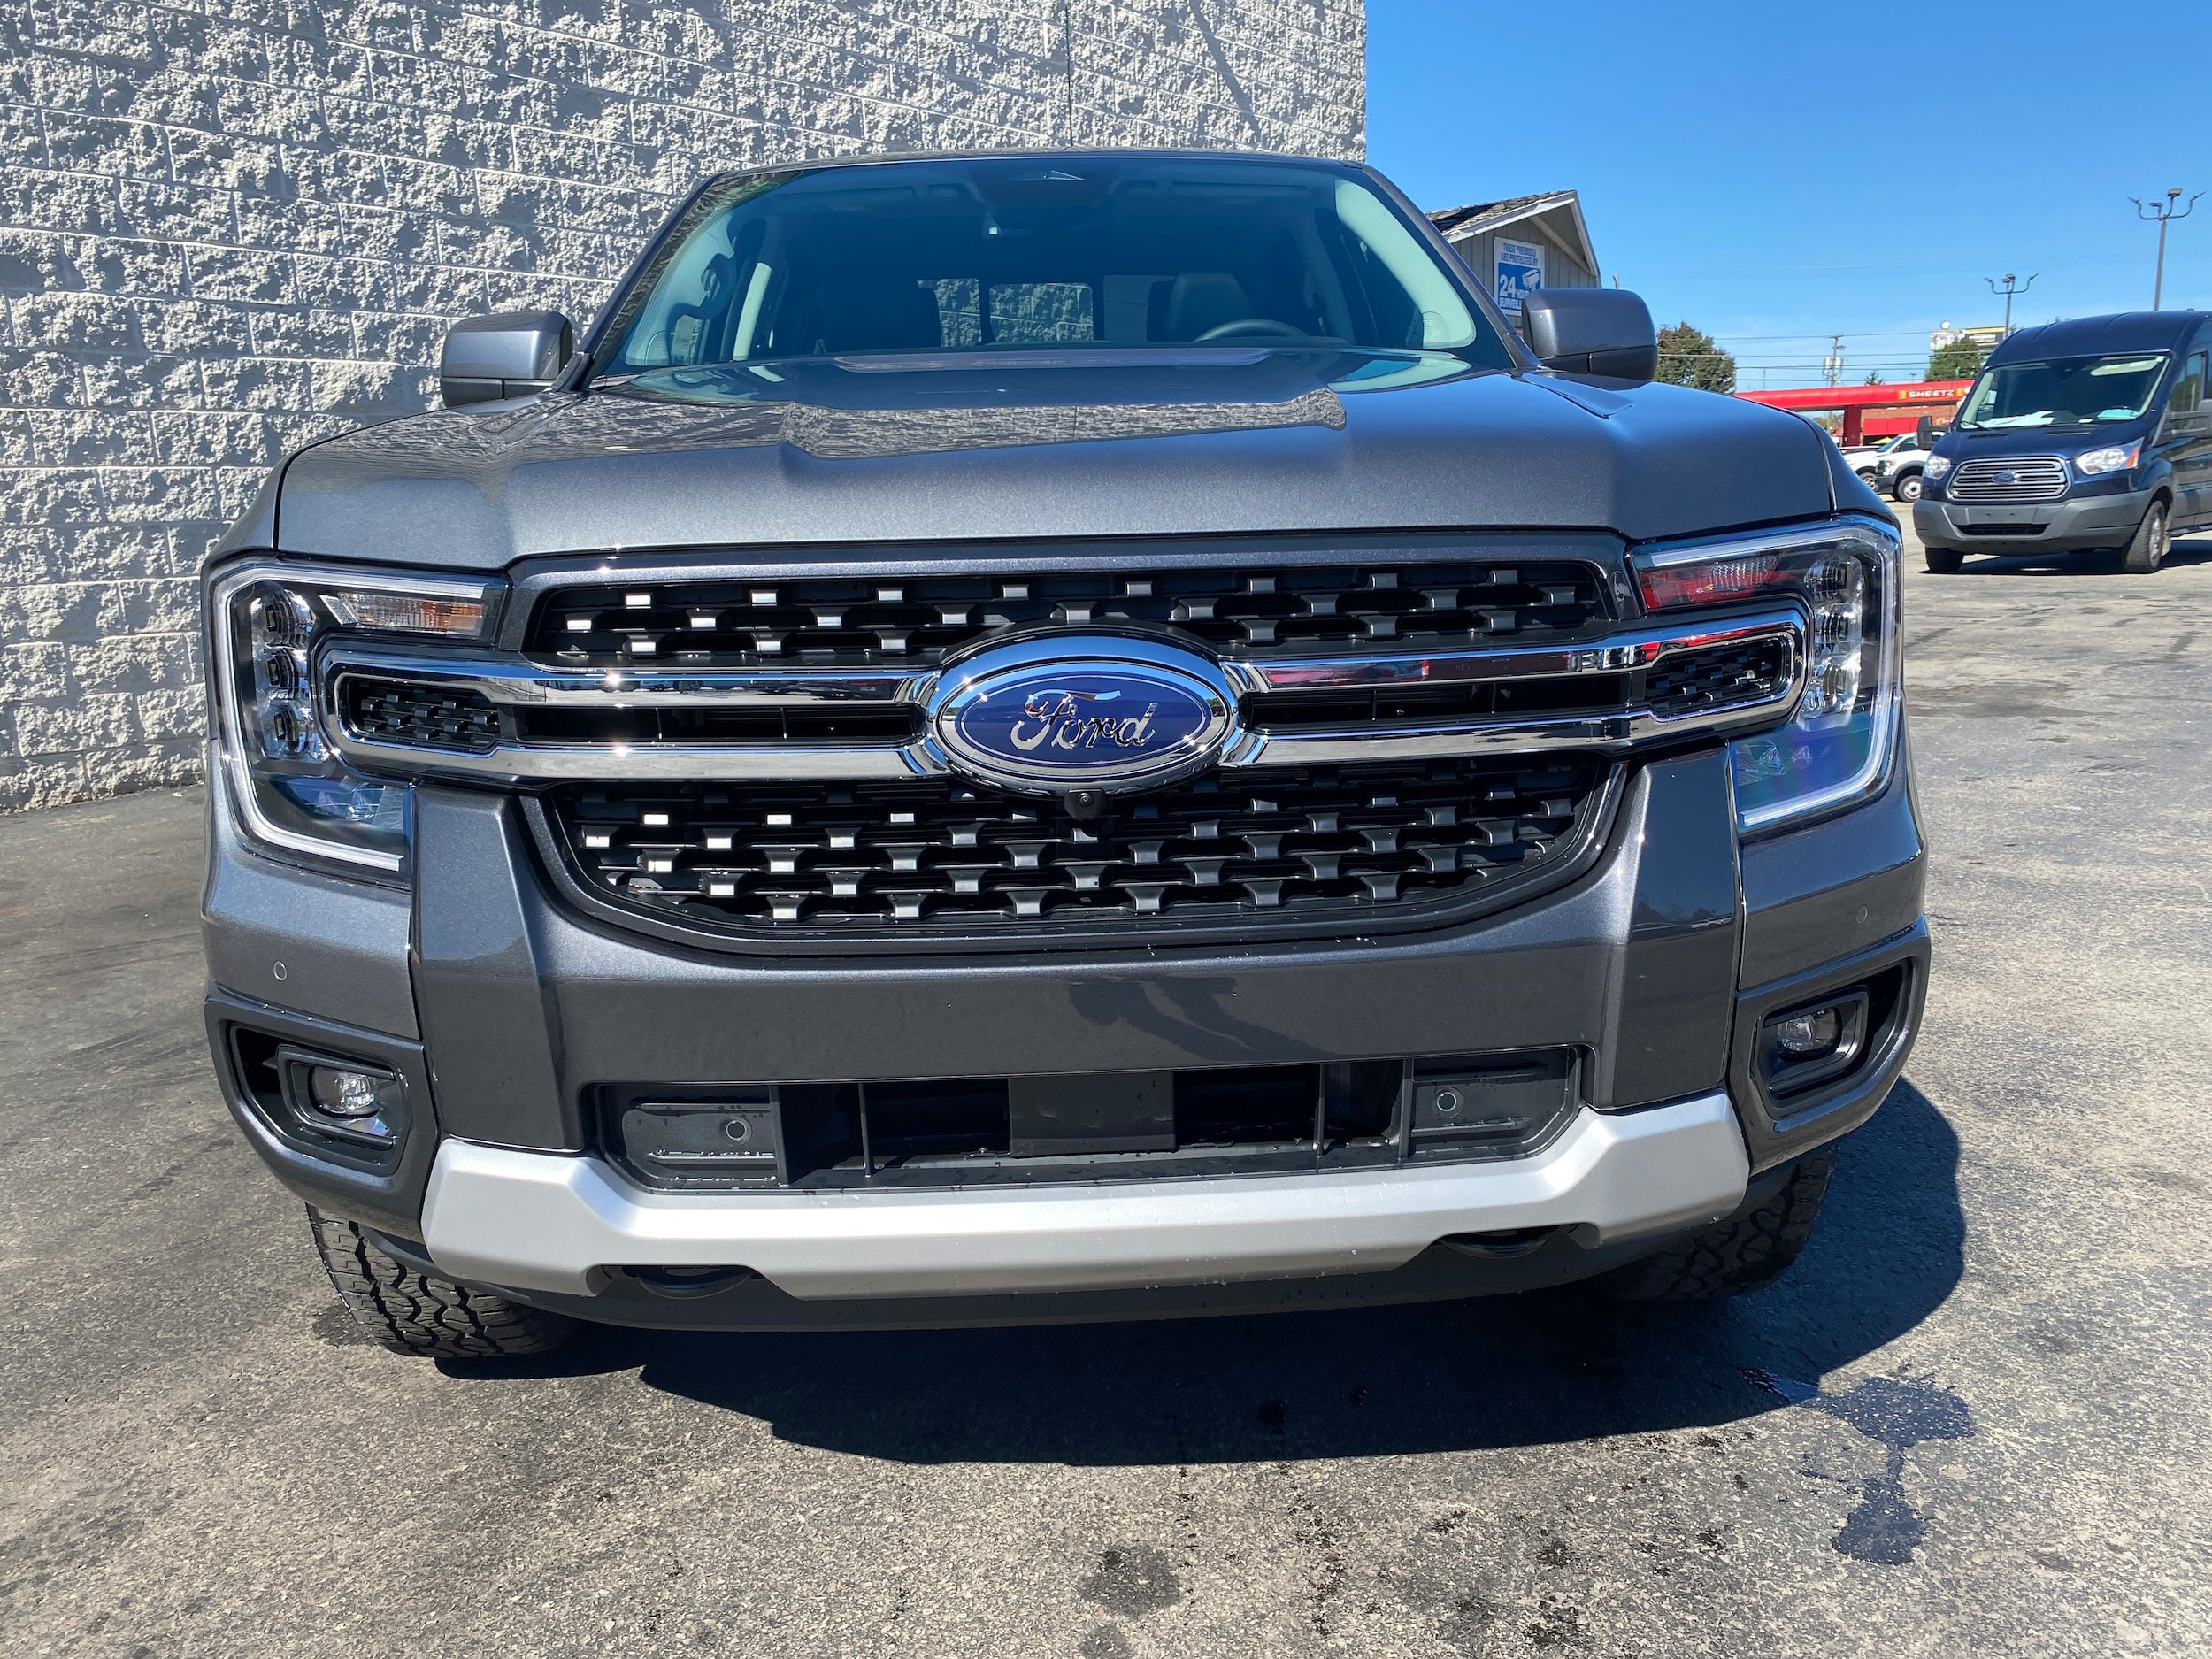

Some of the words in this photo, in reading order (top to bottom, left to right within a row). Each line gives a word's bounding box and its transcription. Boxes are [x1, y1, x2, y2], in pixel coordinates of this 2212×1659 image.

[1500, 274, 1516, 298] 24
[1909, 388, 1954, 397] SHEETZ
[1010, 689, 1158, 750] Ford
